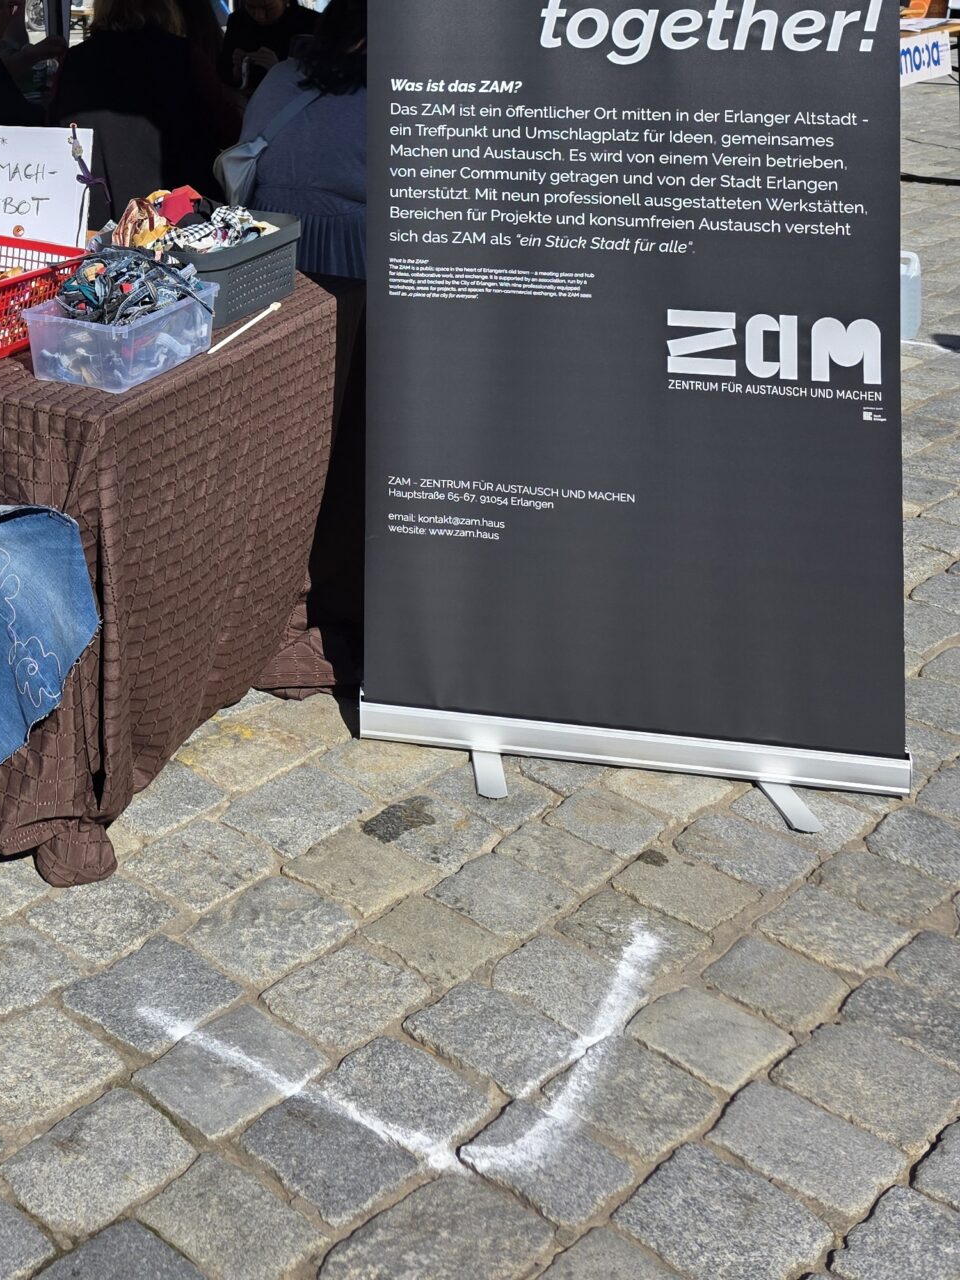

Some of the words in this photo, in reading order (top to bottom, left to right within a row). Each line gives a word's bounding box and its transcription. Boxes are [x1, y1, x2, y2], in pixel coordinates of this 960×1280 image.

[391, 78, 423, 91] Was
[426, 79, 445, 92] ist
[448, 80, 476, 92] das
[478, 80, 522, 93] ZAM?
[391, 103, 418, 115] Das
[421, 103, 455, 116] ZAM
[460, 104, 476, 116] ist
[480, 104, 501, 117] ein
[506, 105, 591, 119] öffentlicher
[594, 107, 618, 120] Ort
[622, 108, 671, 121] mitten
[676, 109, 689, 122] in
[694, 109, 720, 122] der
[725, 110, 791, 127] Erlanger
[794, 112, 857, 125] Altstadt
[390, 123, 411, 136] ein
[415, 124, 488, 140] Treffpunkt
[492, 126, 520, 138] und
[526, 127, 639, 144] Umschlagplatz
[643, 129, 665, 142] für
[670, 130, 716, 144] Ideen,
[721, 132, 834, 147] gemeinsames
[391, 144, 448, 157] Machen
[452, 146, 480, 158] und
[483, 146, 564, 161] Austausch.
[570, 149, 587, 161] Es
[590, 150, 622, 162] wird
[626, 153, 654, 163] von
[659, 152, 708, 165] einem
[712, 153, 761, 167] Verein
[766, 154, 847, 170] betrieben,
[390, 168, 416, 178] von
[420, 166, 457, 178] einer
[460, 167, 546, 184] Community
[550, 170, 618, 186] getragen
[623, 172, 653, 185] und
[657, 176, 685, 186] von
[690, 174, 717, 187] der
[720, 175, 762, 188] Stadt
[767, 176, 838, 194] Erlangen
[475, 188, 498, 200] Mit
[502, 192, 539, 202] neun
[544, 191, 641, 206] professionell
[644, 196, 761, 211] ausgestatteten
[766, 198, 867, 215] Werkstätten,
[390, 206, 462, 220] Bereichen
[467, 208, 487, 221] für
[491, 209, 552, 225] Projekte
[556, 213, 585, 225] und
[590, 213, 694, 230] konsumfreien
[698, 217, 781, 233] Austausch
[785, 222, 851, 235] versteht
[390, 229, 418, 242] sich
[422, 230, 448, 243] das
[452, 231, 486, 244] ZAM
[490, 233, 511, 245] als
[545, 235, 587, 249] Stück
[590, 237, 631, 250] Stadt
[634, 238, 656, 254] für
[668, 379, 718, 391] ZENTRUM
[722, 381, 742, 393] FÜR
[745, 384, 807, 397] AUSTAUSCH
[810, 388, 833, 398] UND
[836, 389, 882, 401] MACHEN
[388, 476, 410, 486] ZAM
[420, 479, 470, 489] ZENTRUM
[473, 480, 493, 491] FÜR
[495, 484, 559, 497] AUSTAUSCH
[562, 489, 585, 499] UND
[588, 491, 635, 503] MACHEN
[389, 488, 445, 500] Hauptstraße
[480, 495, 508, 506] 91054
[511, 497, 554, 510] Erlangen
[388, 513, 415, 522] email:
[418, 514, 505, 528] kontakt@zam.haus
[388, 525, 427, 535] website:
[429, 528, 499, 540] www.zam.haus
